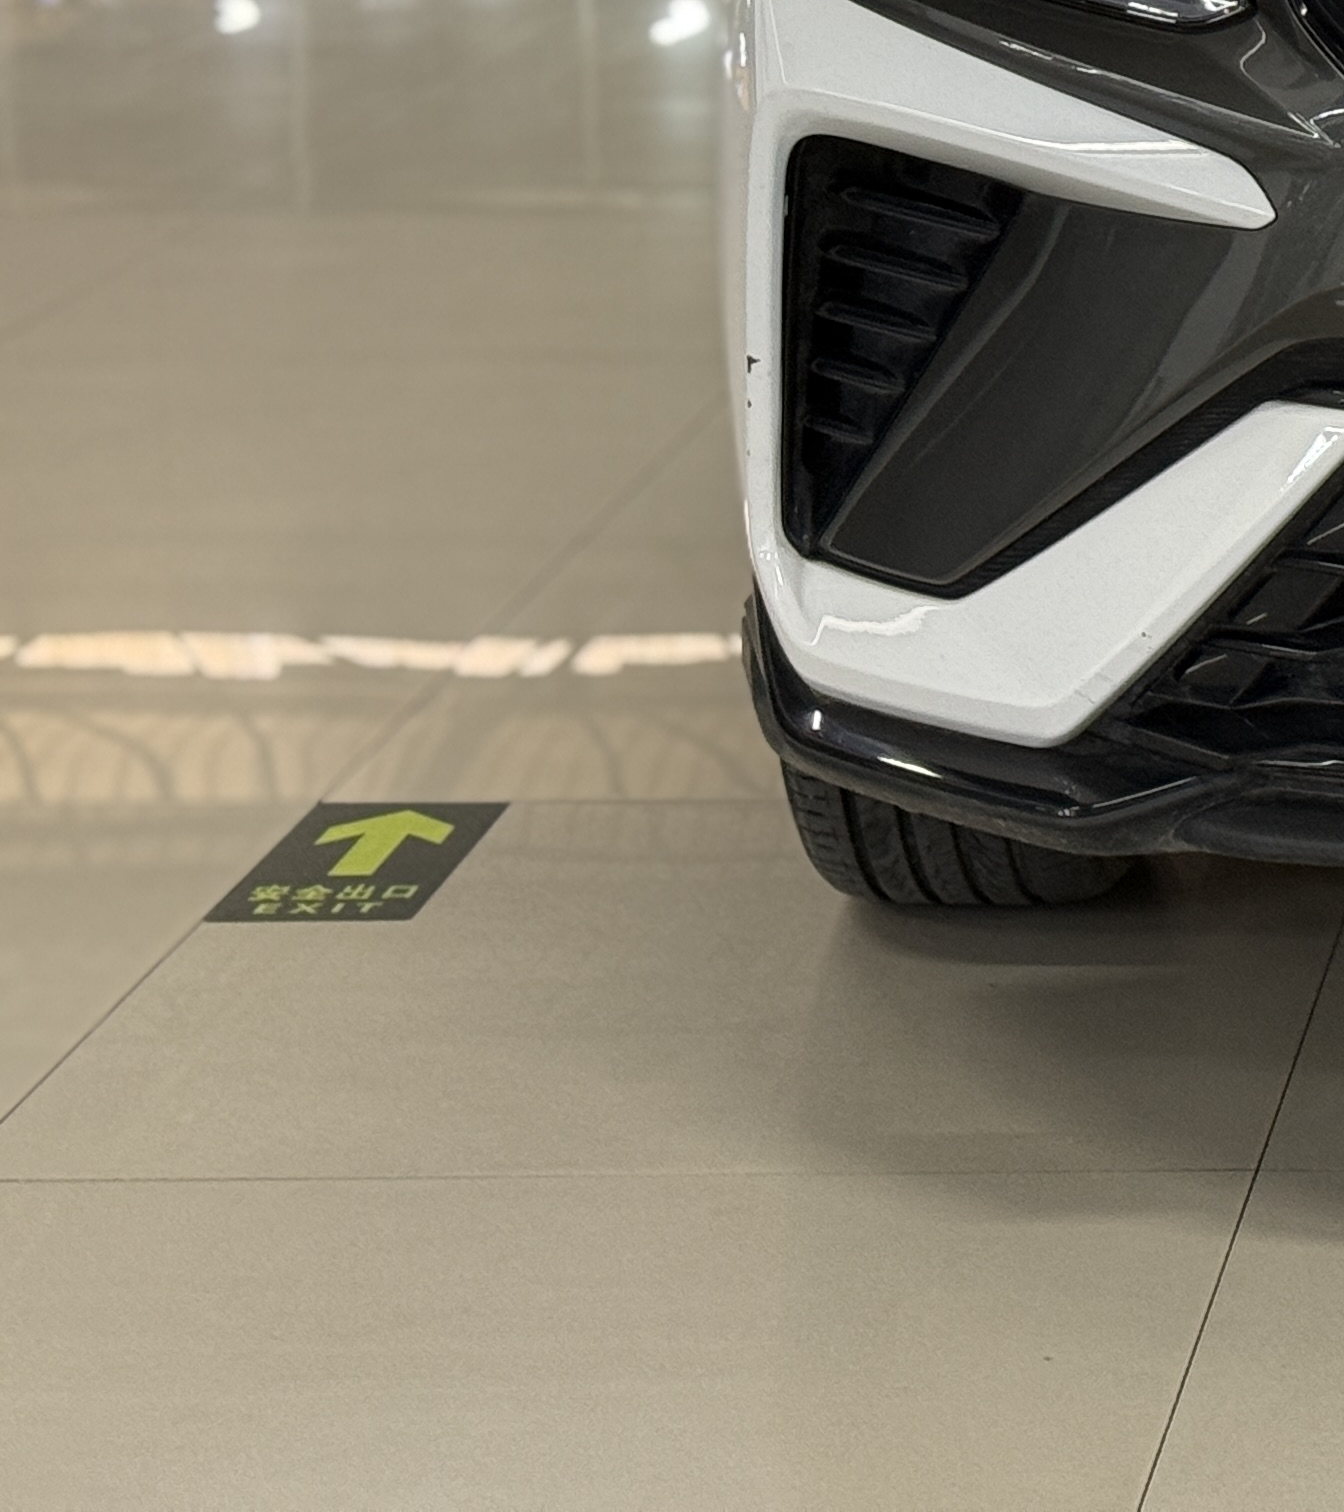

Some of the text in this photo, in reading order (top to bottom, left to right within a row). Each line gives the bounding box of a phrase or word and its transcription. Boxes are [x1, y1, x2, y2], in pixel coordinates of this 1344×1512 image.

[247, 883, 419, 901] 安全出口
[252, 901, 384, 915] EXIT
